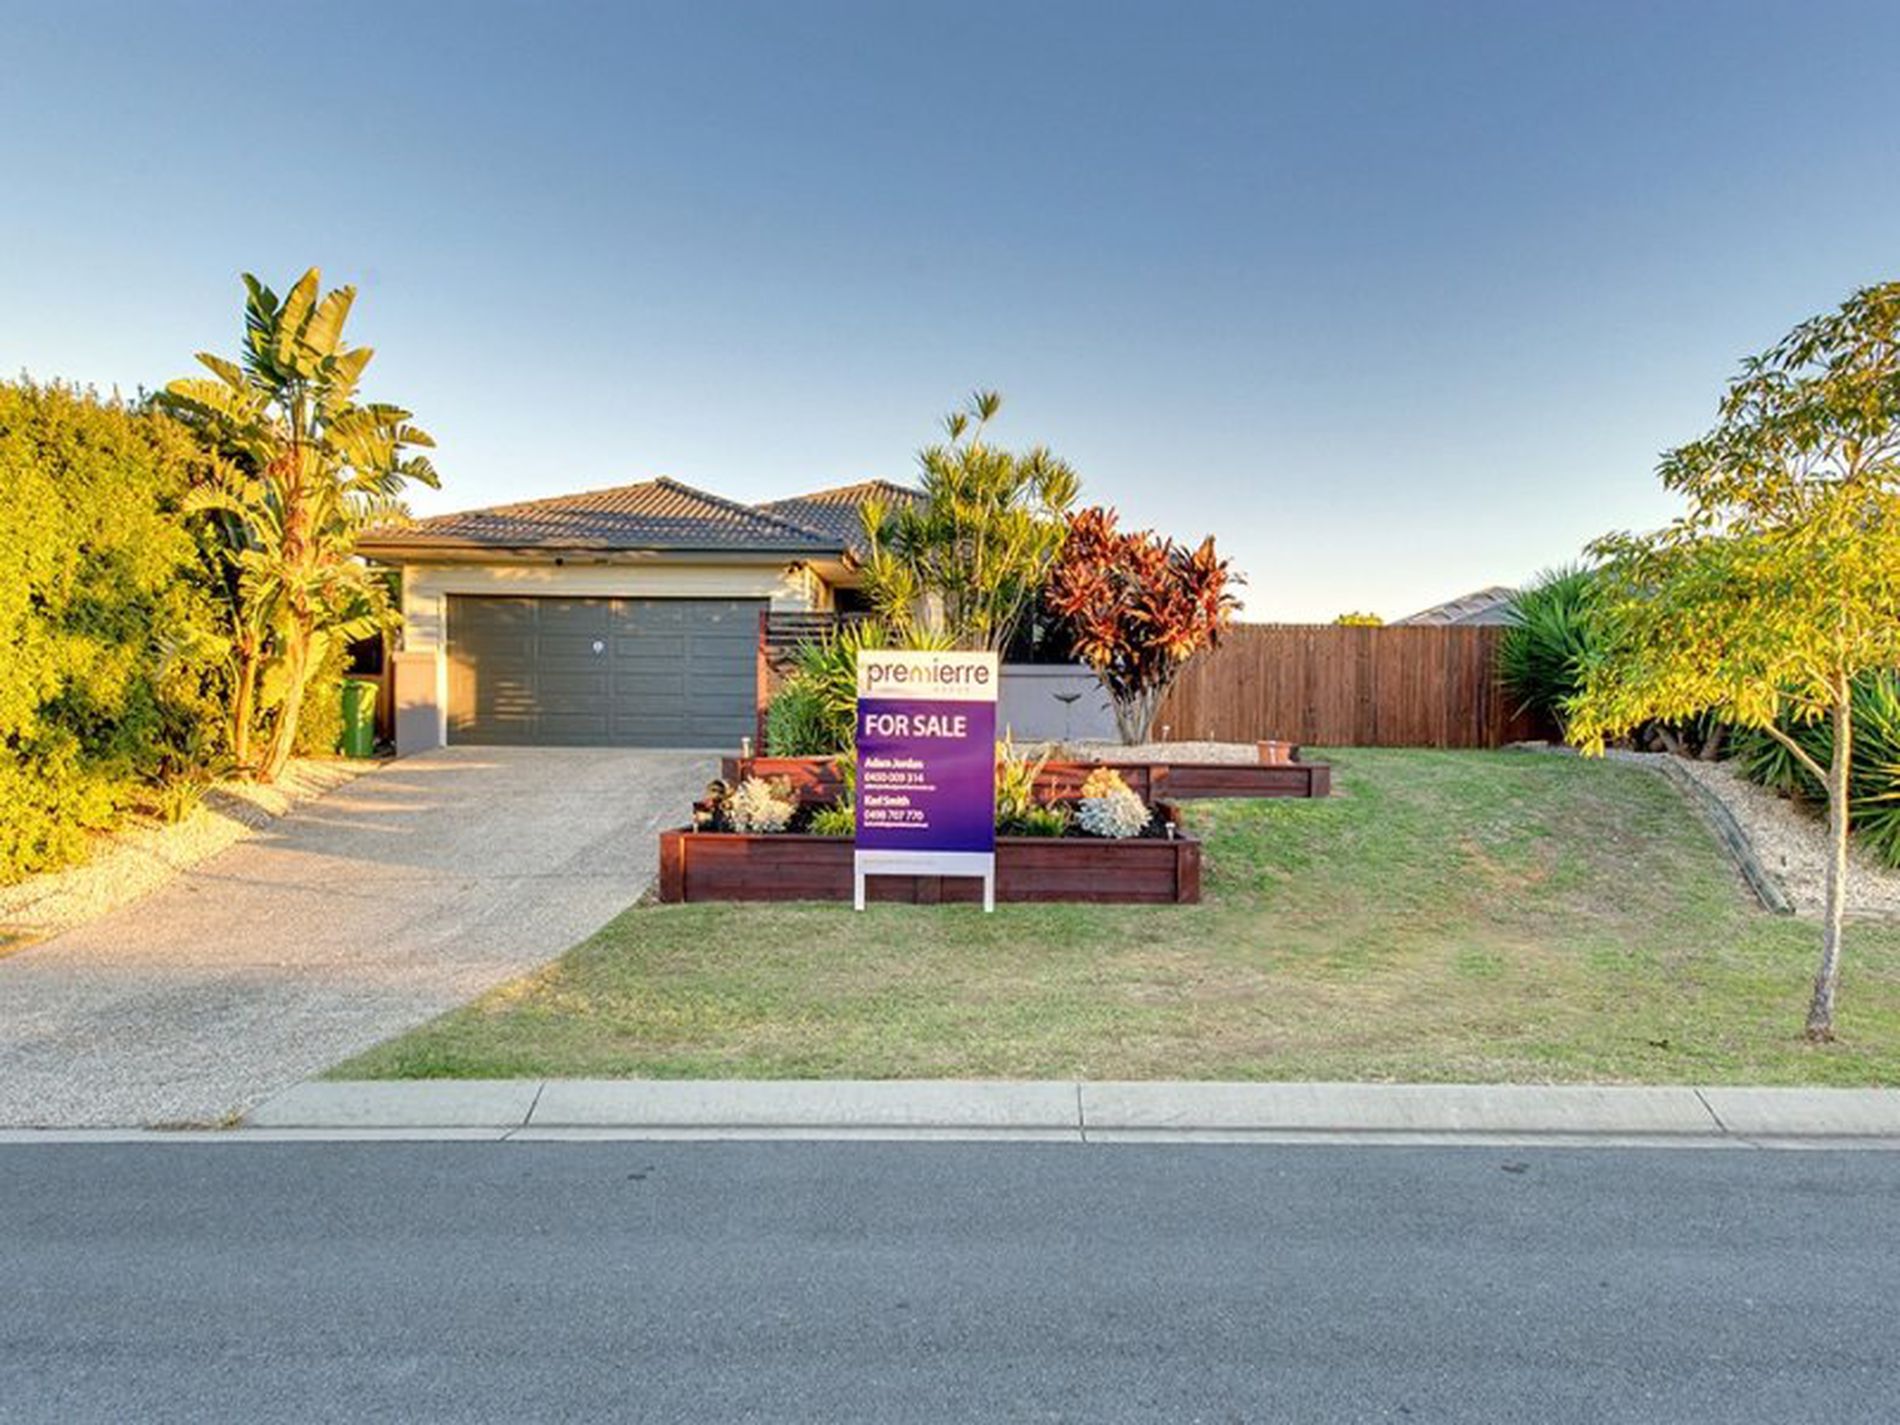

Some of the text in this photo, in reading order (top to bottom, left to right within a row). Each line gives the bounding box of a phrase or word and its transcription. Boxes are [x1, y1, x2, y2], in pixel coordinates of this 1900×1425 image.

[867, 657, 989, 690] premierre
[865, 714, 967, 738] FOR SALE
